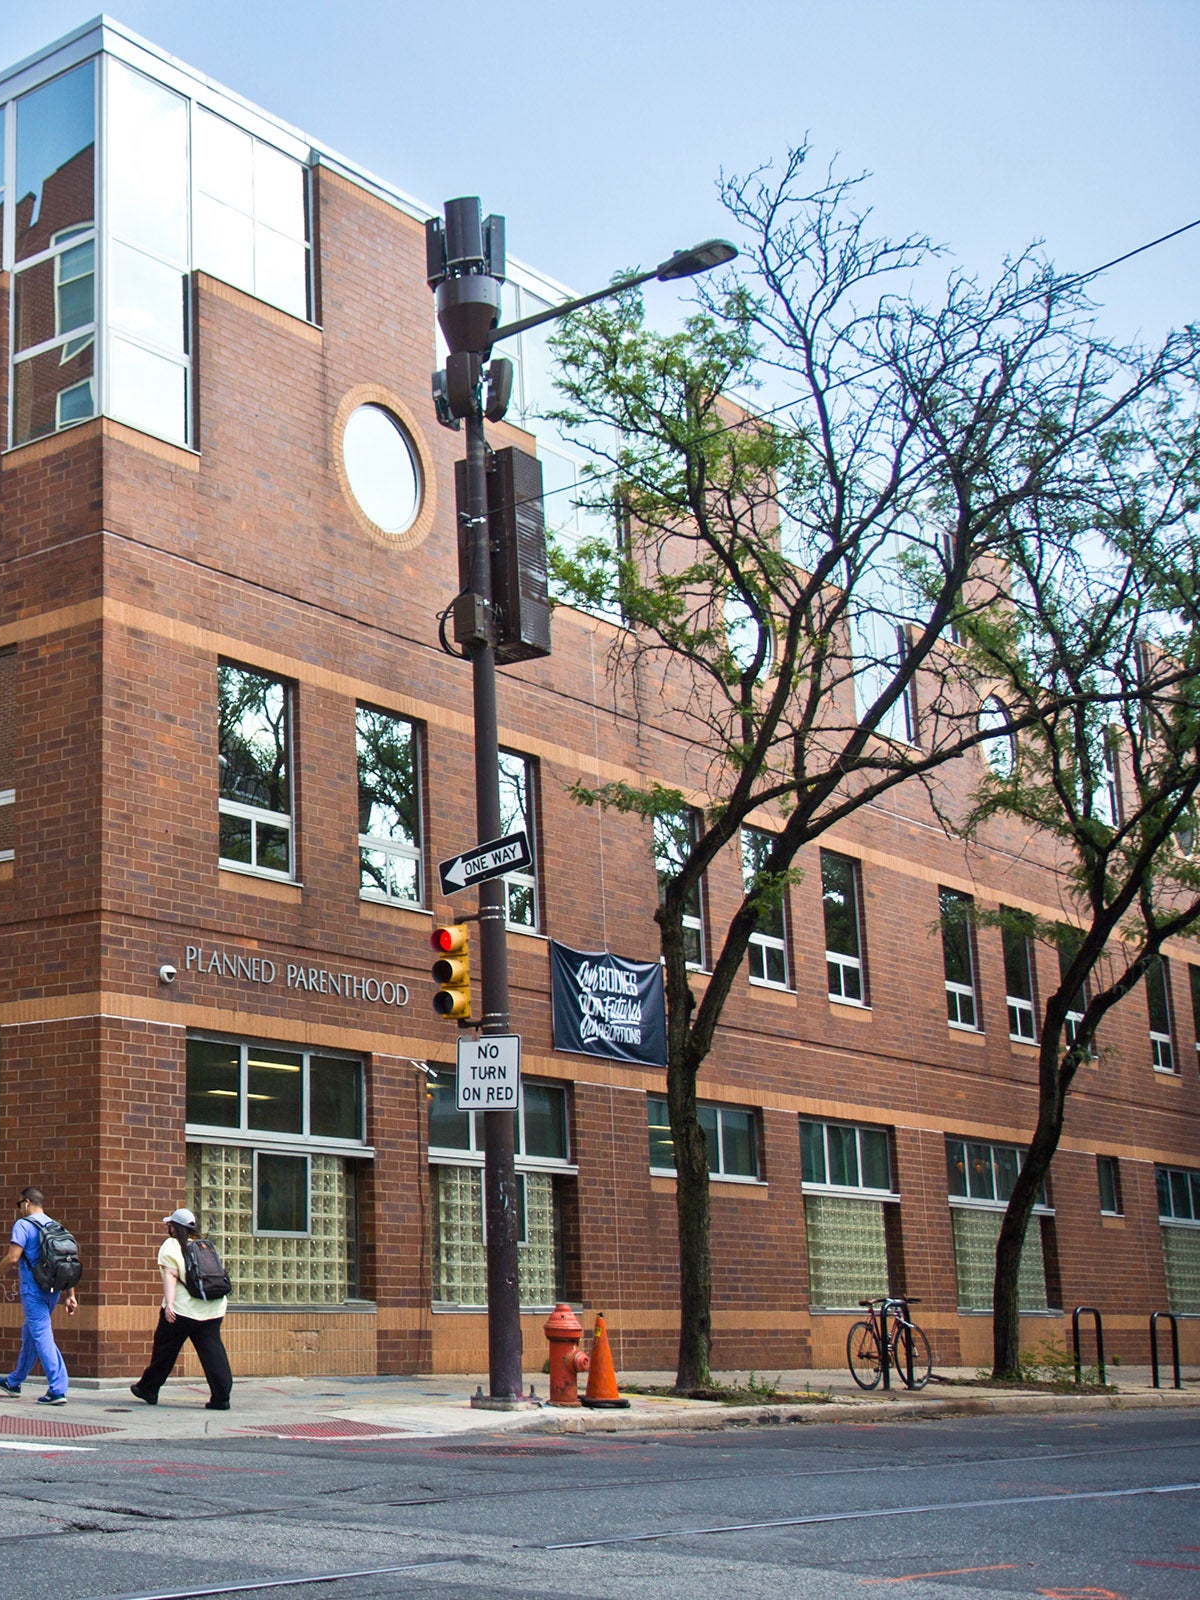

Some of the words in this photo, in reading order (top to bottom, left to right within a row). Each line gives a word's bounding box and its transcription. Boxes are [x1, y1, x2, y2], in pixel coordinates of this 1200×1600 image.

[465, 856, 489, 876] ONE
[491, 845, 517, 866] WAY
[185, 945, 276, 984] PLANNED
[287, 964, 409, 1007] PARENTHOOD
[598, 966, 638, 996] BODIES
[603, 995, 641, 1024] Futures
[598, 1024, 641, 1045] ABORTIONS
[478, 1045, 499, 1059] NO
[470, 1066, 506, 1080] TURN
[463, 1087, 480, 1101] ON
[487, 1086, 513, 1101] RED
